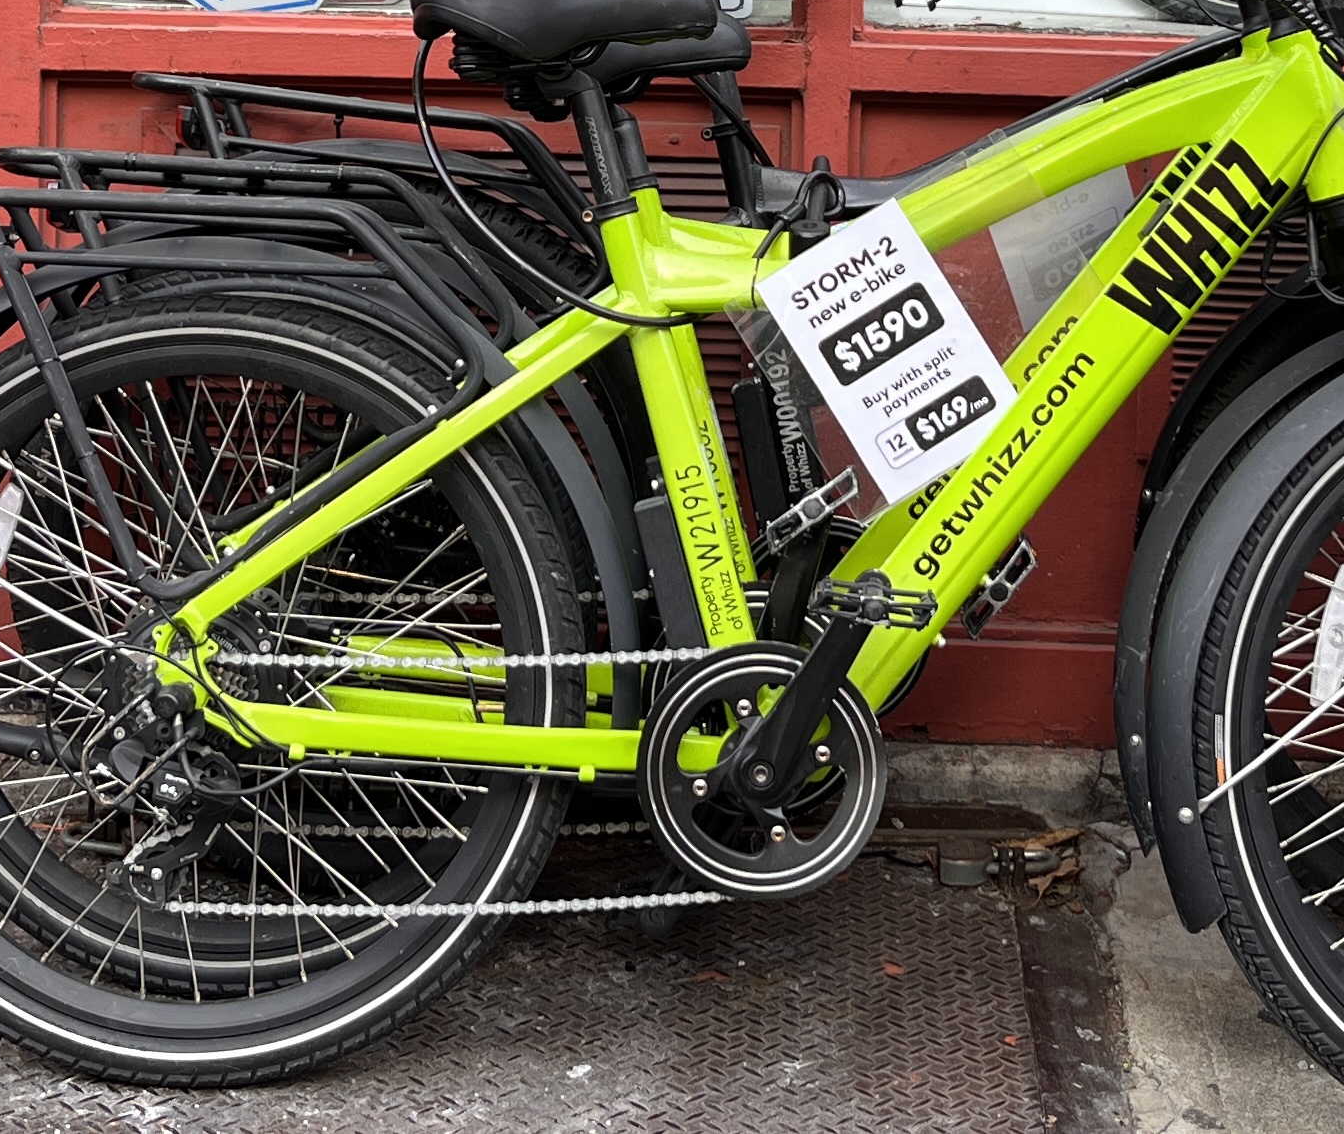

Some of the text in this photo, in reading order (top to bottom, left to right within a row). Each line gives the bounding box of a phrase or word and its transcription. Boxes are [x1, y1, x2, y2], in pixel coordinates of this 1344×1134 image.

[1104, 138, 1291, 336] WHIZZ
[790, 236, 899, 311] STORM-2
[807, 261, 907, 329] new e-bike
[834, 298, 929, 372] $1590
[862, 345, 956, 410] Buy with split
[882, 367, 952, 418] payments
[886, 433, 908, 452] 12
[913, 352, 1095, 580] getwhizz.com
[700, 576, 725, 636] Property
[720, 570, 743, 630] of Whizz
